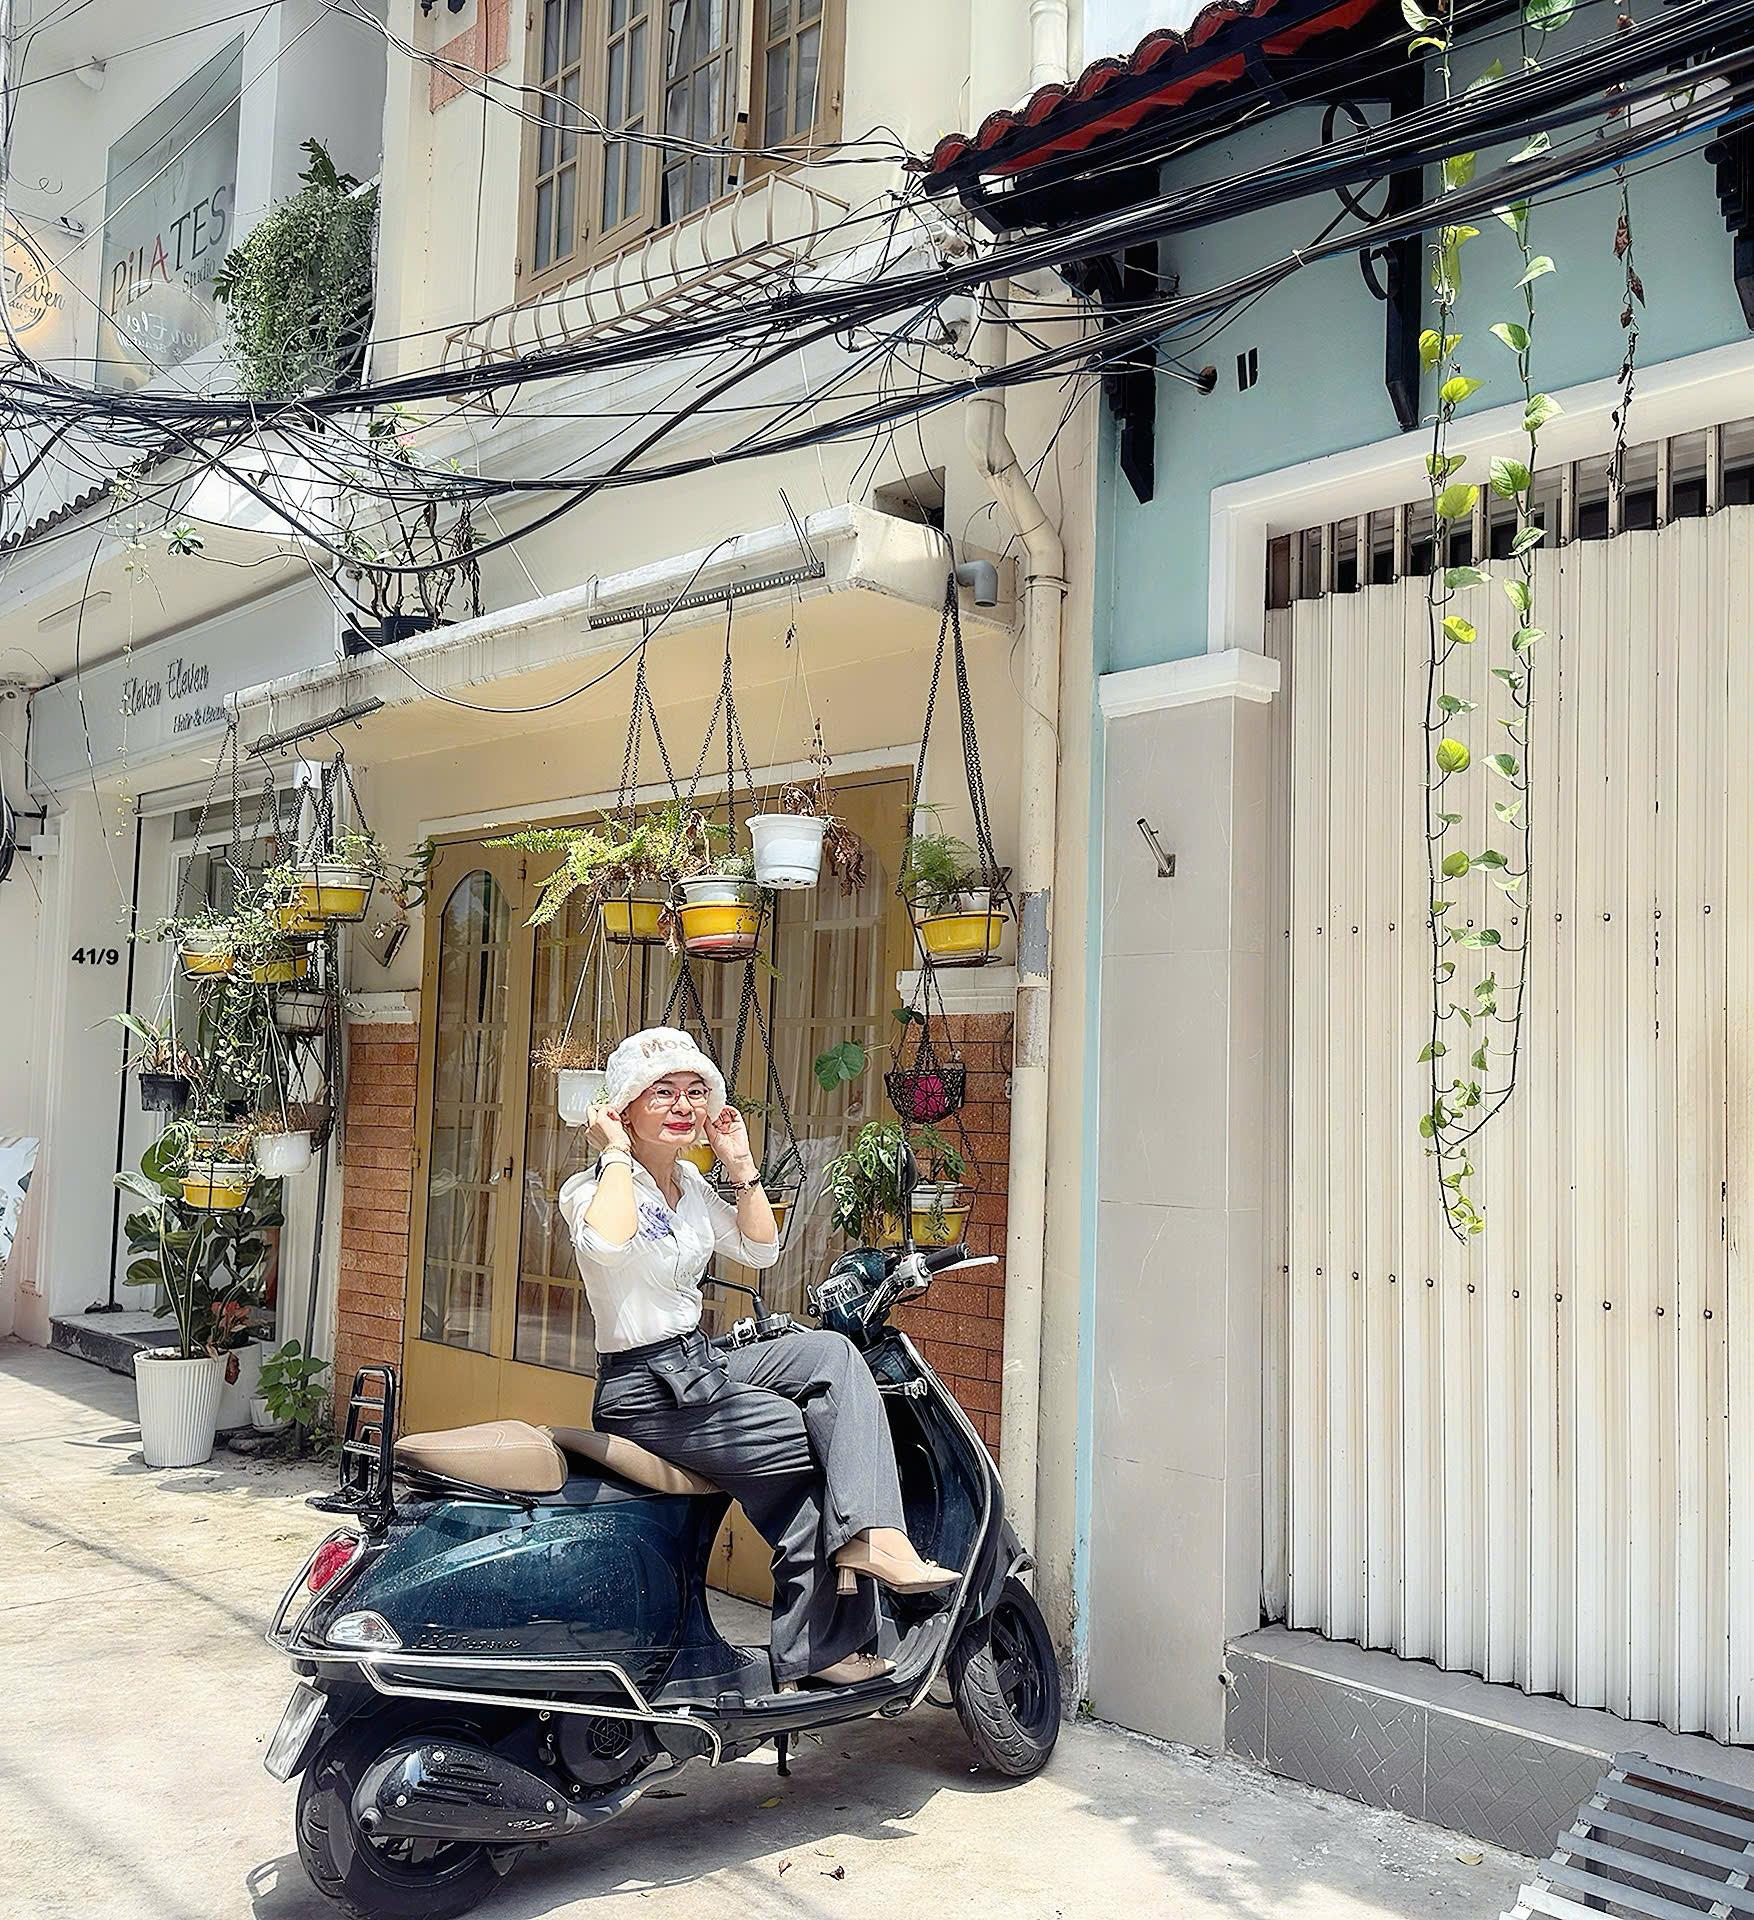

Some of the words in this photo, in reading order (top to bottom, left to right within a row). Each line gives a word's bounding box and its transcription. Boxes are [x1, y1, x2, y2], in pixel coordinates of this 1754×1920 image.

[183, 258, 216, 293] Studio
[121, 677, 161, 716] Eleven
[166, 658, 210, 700] Eleven
[71, 947, 119, 965] 41/9
